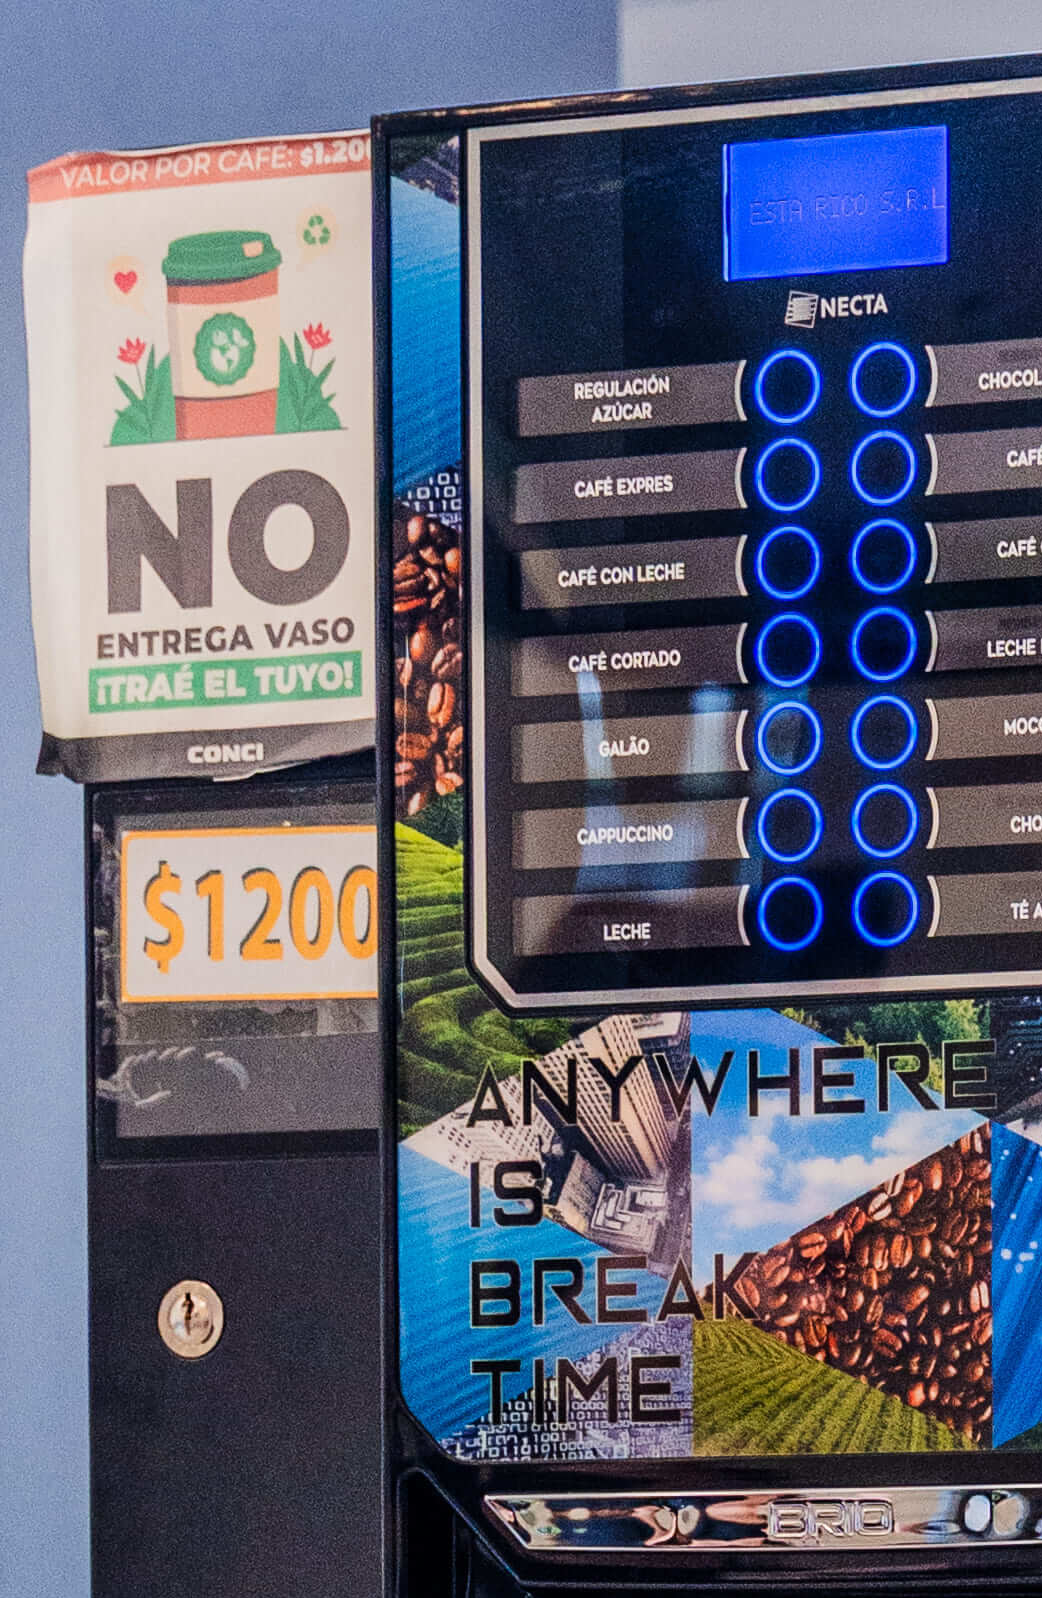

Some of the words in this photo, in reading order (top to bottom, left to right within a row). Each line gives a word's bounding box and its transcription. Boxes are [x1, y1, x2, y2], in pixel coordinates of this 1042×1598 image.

[60, 159, 149, 189] VALOR
[155, 154, 210, 181] POR
[218, 146, 293, 173] CAFÉ:
[820, 293, 889, 319] NECTA
[574, 374, 670, 400] REGULACIÓN
[591, 401, 653, 424] AZÚCAR
[574, 475, 613, 498] CAFÉ
[616, 474, 673, 496] EXPRES
[106, 469, 350, 615] NO
[997, 535, 1037, 559] CAFÉ
[558, 565, 597, 588] CAFÉ
[600, 566, 634, 586] CON
[637, 562, 685, 583] LECHE
[97, 623, 253, 660] ENTREGA
[264, 616, 355, 649] VASO
[987, 637, 1036, 659] LECHE
[568, 650, 607, 673] CAFÉ
[611, 649, 681, 671] CORTADO
[97, 664, 194, 706] ¡TRAÉ
[204, 668, 246, 699] EL
[254, 660, 355, 695] TUYO!
[187, 742, 265, 764] CONCI
[599, 736, 650, 759] GALÃO
[577, 824, 673, 845] CAPPUCCINO
[143, 860, 378, 974] $1200
[1010, 898, 1030, 921] TÉ
[603, 922, 651, 941] LECHE
[466, 1039, 999, 1129] ANYWHERE
[469, 1159, 544, 1229] IS
[469, 1251, 762, 1329] BREAK
[470, 1353, 682, 1426] TIME
[767, 1498, 895, 1540] BRIO
